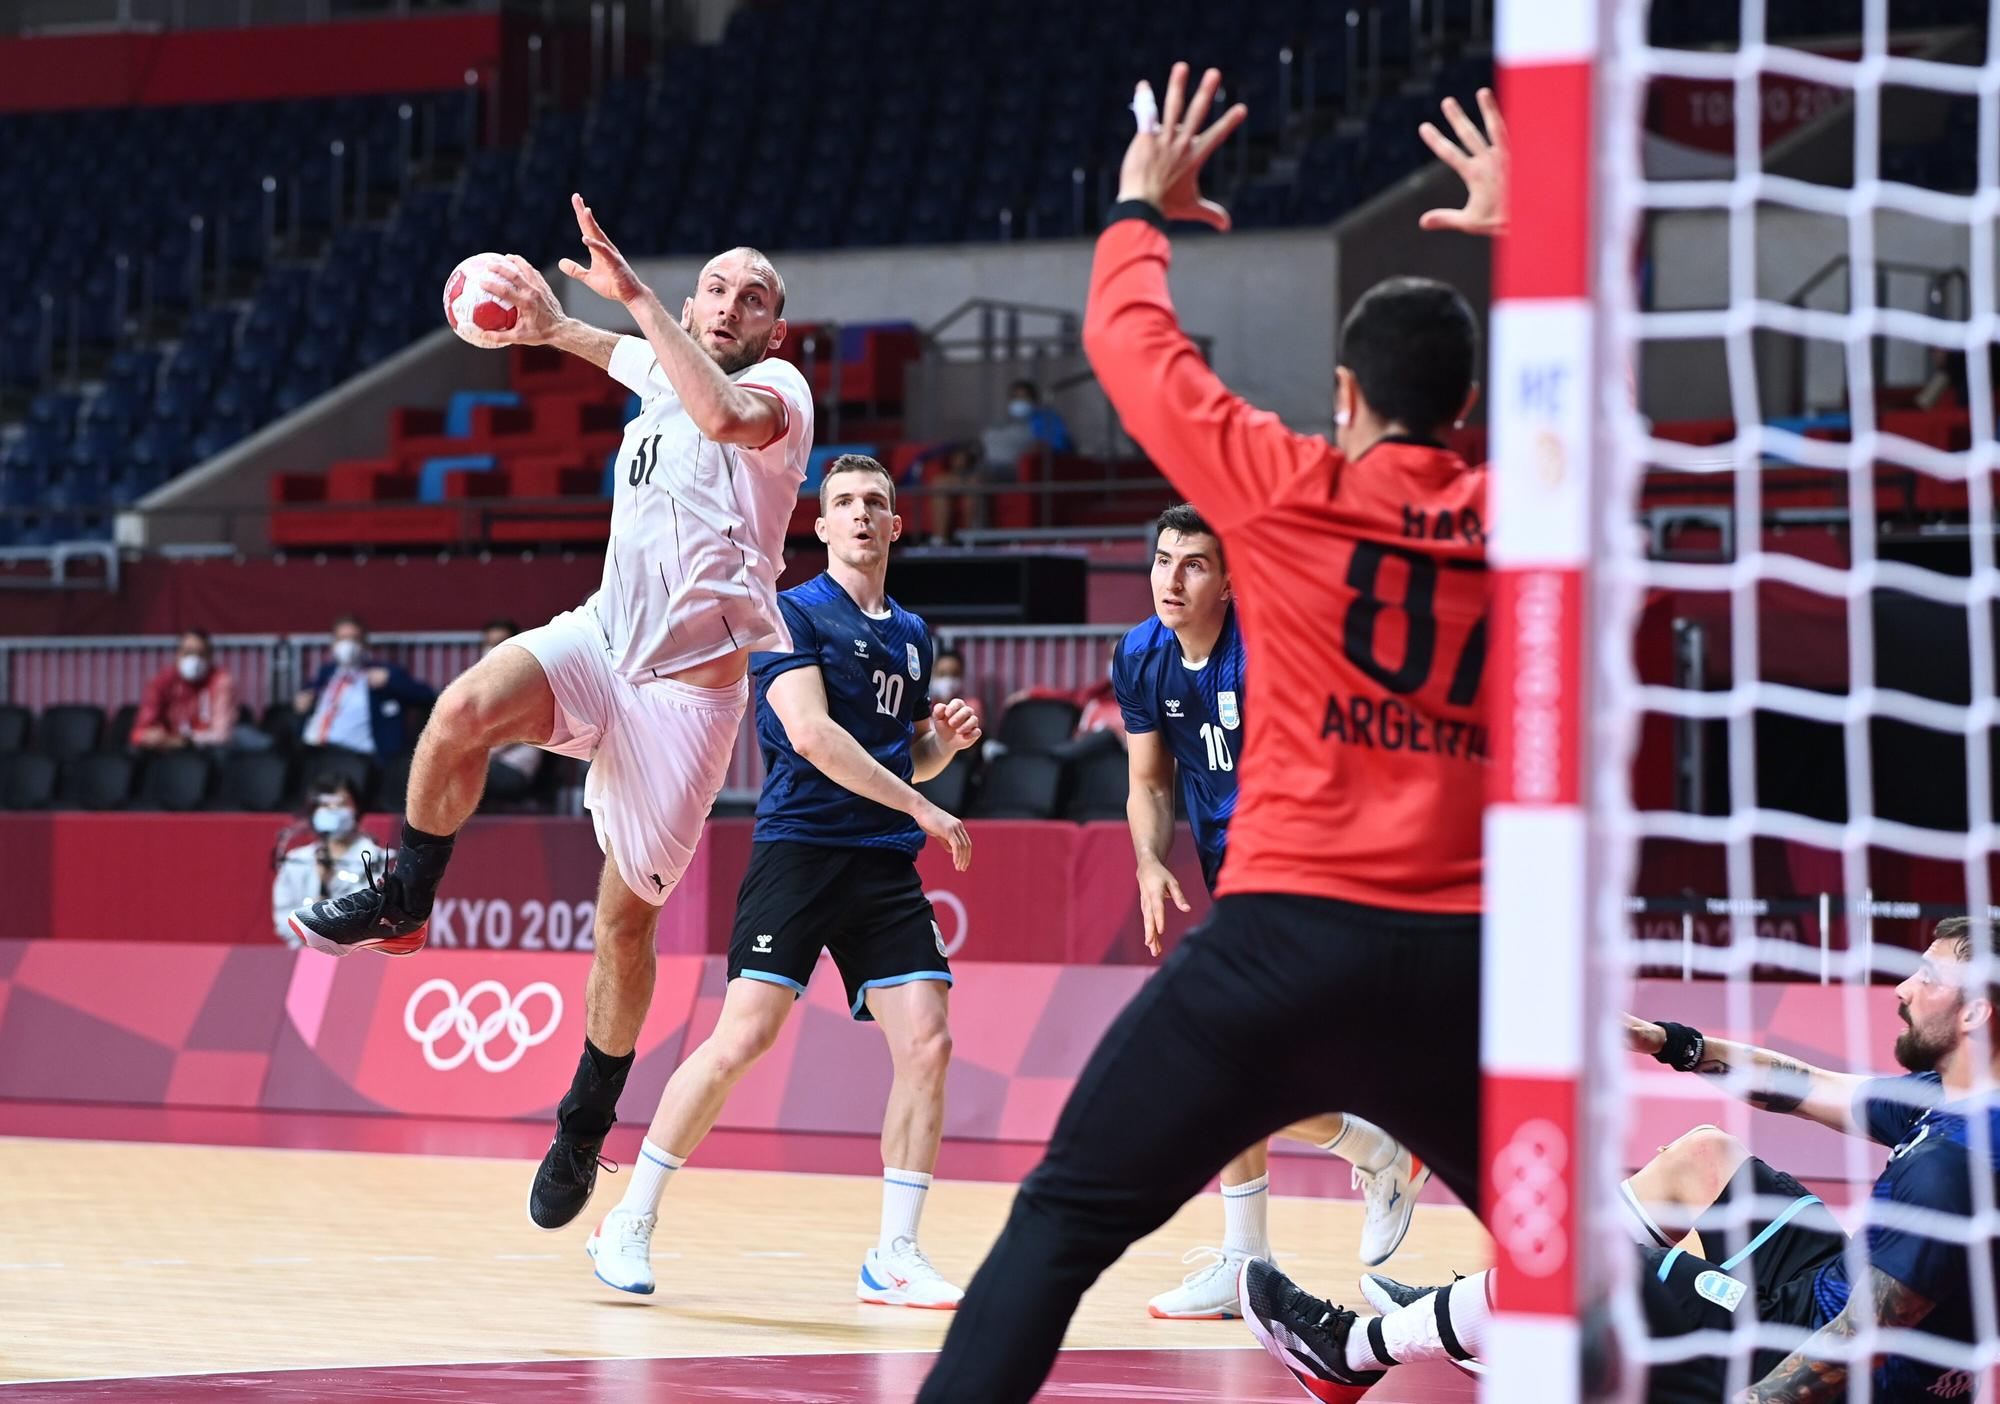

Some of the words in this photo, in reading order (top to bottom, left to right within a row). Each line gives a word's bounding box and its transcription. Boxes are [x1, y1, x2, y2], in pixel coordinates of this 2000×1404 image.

[1687, 86, 1791, 127] TOO
[1344, 538, 1489, 707] 87
[872, 669, 904, 719] 20
[1199, 723, 1233, 772] 10
[430, 898, 513, 948] KYO
[519, 900, 598, 950] 202
